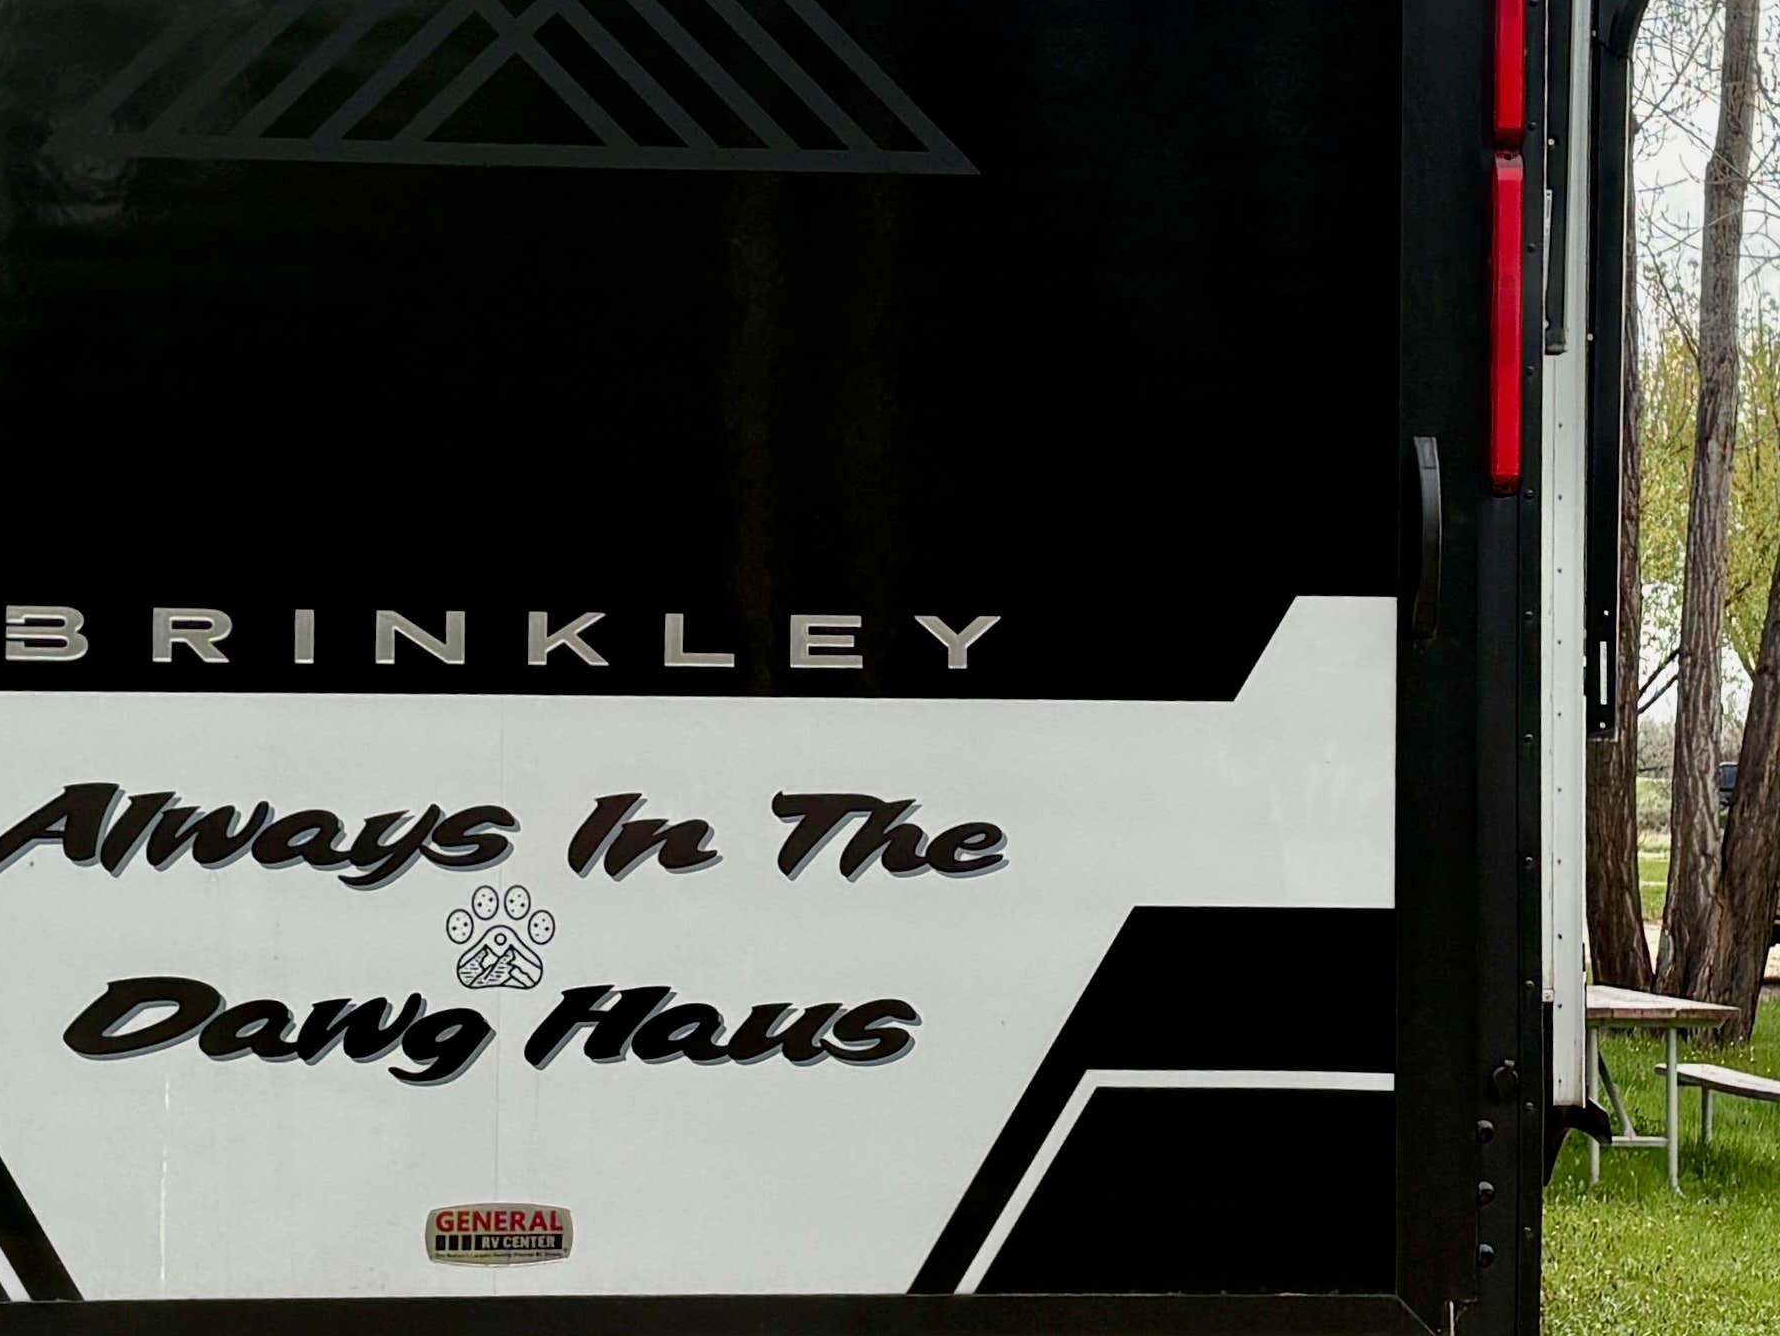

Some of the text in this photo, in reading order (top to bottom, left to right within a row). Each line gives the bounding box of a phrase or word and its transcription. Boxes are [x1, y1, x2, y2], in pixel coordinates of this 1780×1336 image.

[3, 603, 1003, 671] BRINKLEY
[567, 792, 725, 884] In
[771, 790, 1011, 884] The
[62, 976, 924, 1087] Dawg Haus
[436, 1210, 563, 1233] GENERAL
[481, 1235, 556, 1249] RV CENTER
